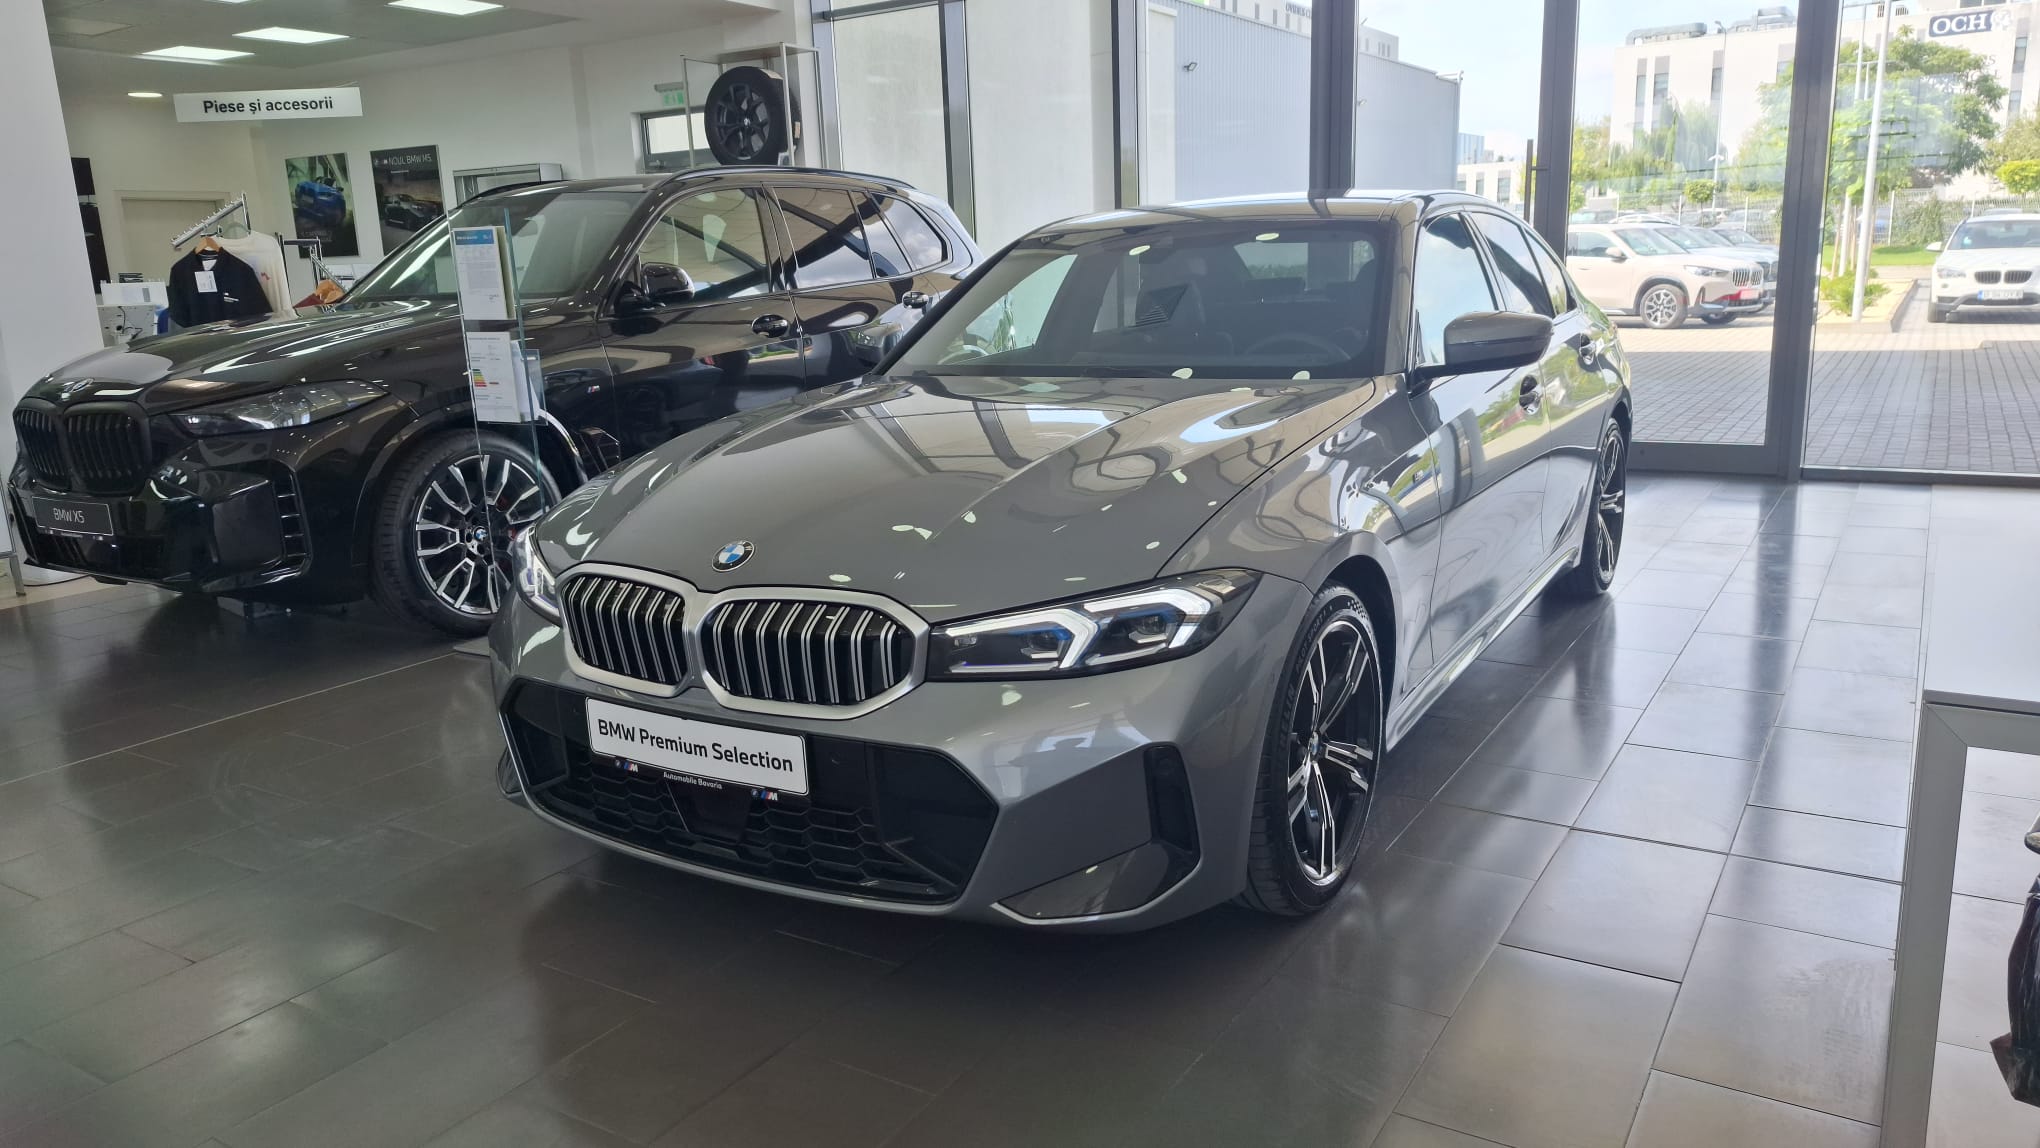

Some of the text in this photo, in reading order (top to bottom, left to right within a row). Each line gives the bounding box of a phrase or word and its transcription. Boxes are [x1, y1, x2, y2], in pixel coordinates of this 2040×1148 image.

[1932, 13, 1988, 34] OCH
[203, 96, 334, 115] Piese și accesorii
[53, 507, 85, 524] BMW X5
[598, 718, 793, 772] BMW Premium Selection
[663, 771, 723, 790] Automobile Bavaria
